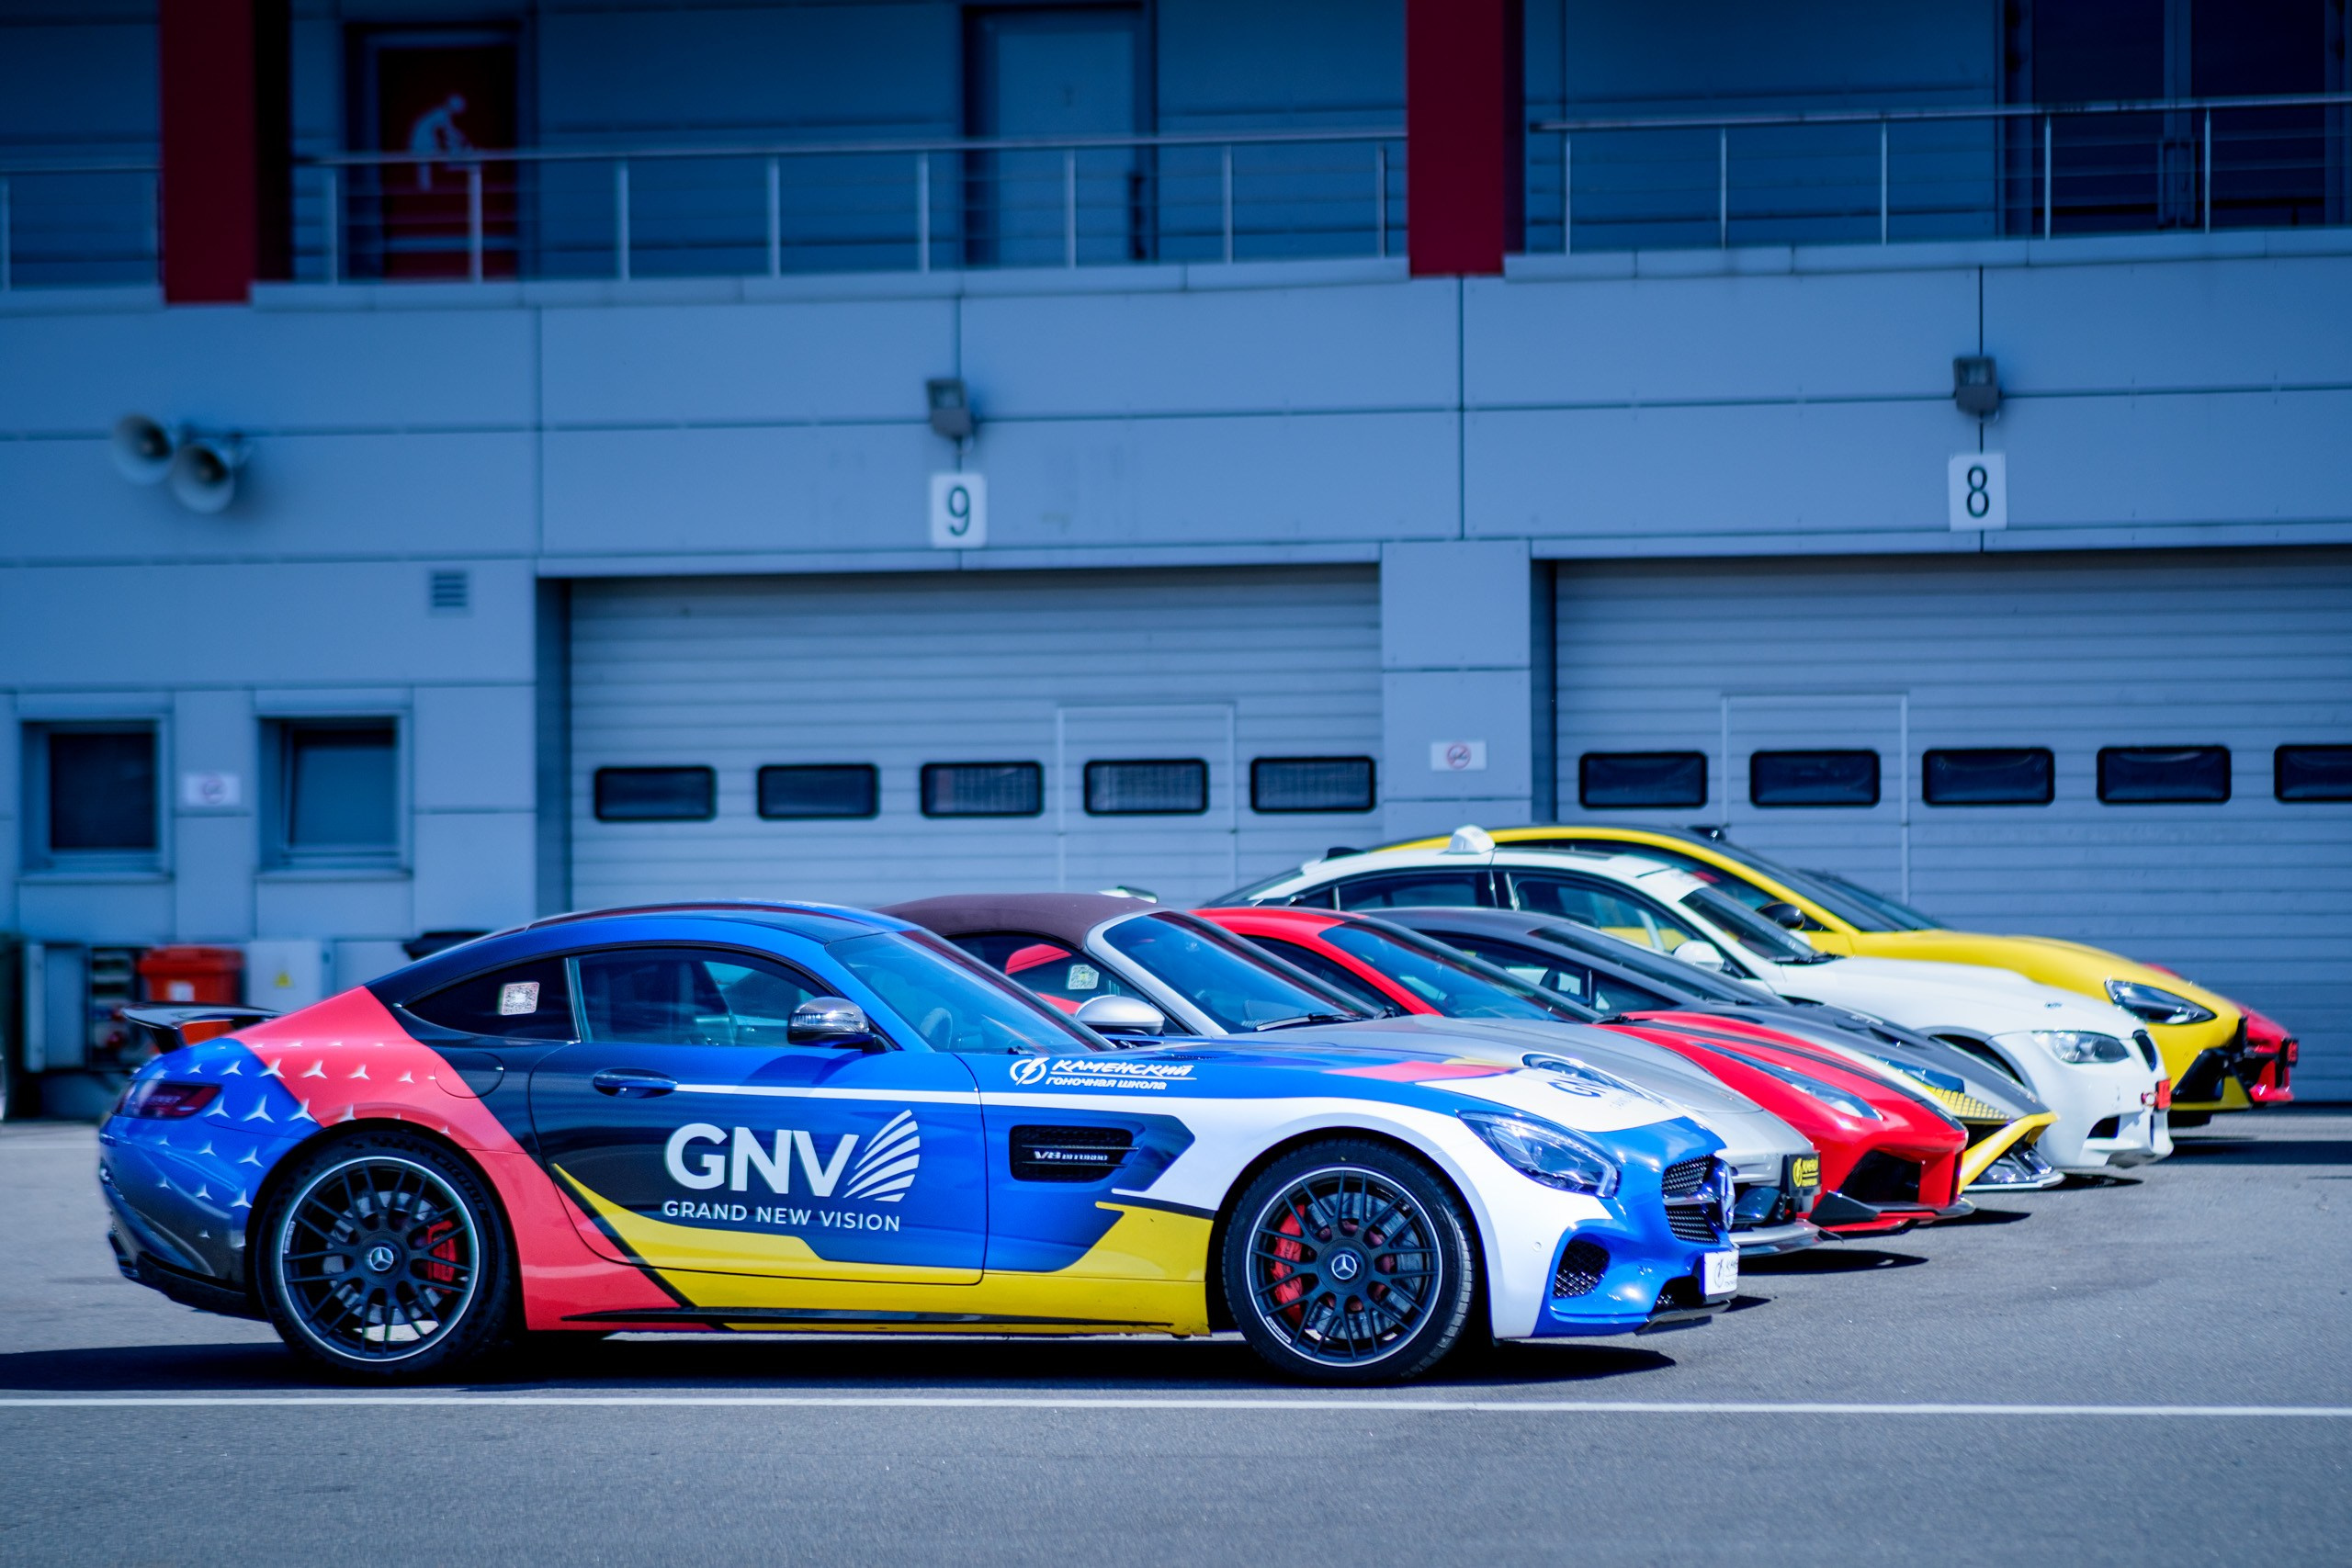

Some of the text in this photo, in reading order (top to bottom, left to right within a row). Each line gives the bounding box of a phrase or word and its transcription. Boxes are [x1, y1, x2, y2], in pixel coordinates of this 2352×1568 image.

[947, 485, 970, 536] 9
[1966, 465, 1990, 518] 8
[1052, 1059, 1194, 1077] КАМЕНСКИЙ
[664, 1122, 860, 1197] GNV
[1034, 1151, 1061, 1159] V8
[662, 1201, 901, 1232] GRAND NEW VISION
